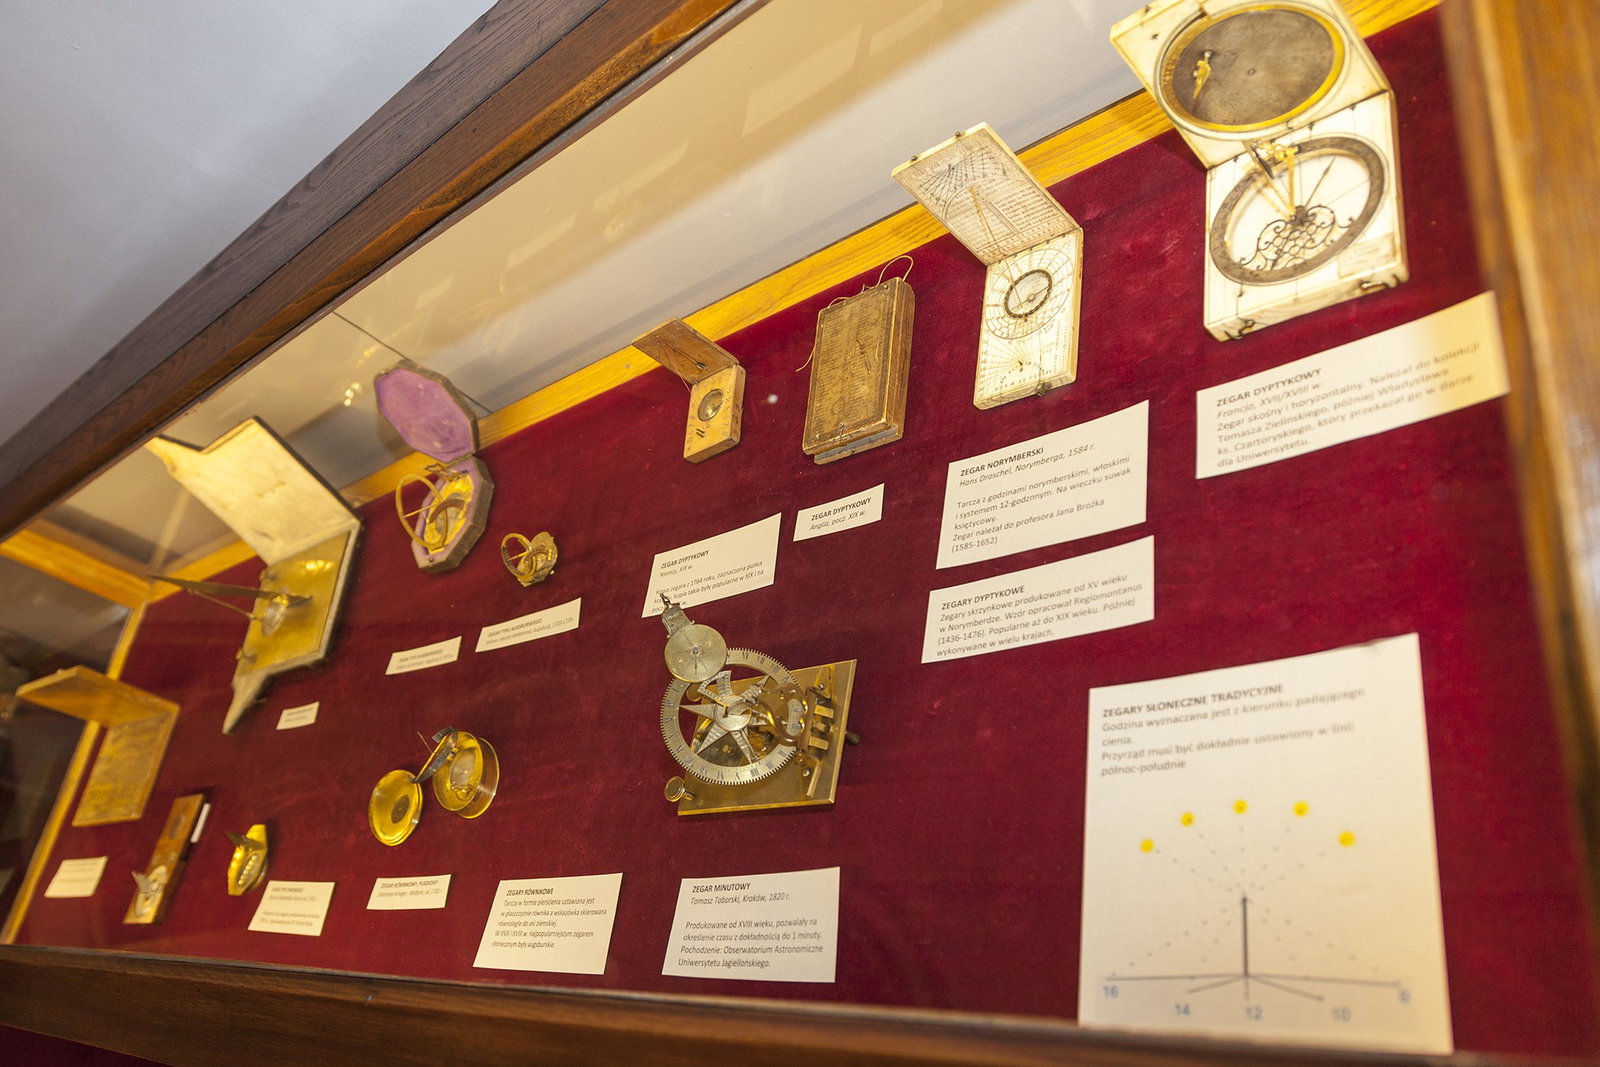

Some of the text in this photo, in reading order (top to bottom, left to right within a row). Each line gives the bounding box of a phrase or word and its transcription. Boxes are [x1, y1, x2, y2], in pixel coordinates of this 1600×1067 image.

[1217, 369, 1320, 407] ZEGAR DYPTYKOWY
[1217, 403, 1257, 419] Francja,
[1217, 418, 1245, 431] Zegar
[1248, 408, 1283, 423] skośny
[1318, 415, 1345, 427] który
[1218, 426, 1262, 443] Tomasza
[959, 478, 978, 487] Hans
[979, 467, 1013, 483] Droschel,
[1015, 453, 1065, 472] Norymberga,
[1068, 444, 1088, 457] 1584
[960, 447, 1043, 477] ZEGAR NORYMBERSKI
[1218, 458, 1234, 467] dla
[957, 499, 981, 508] Tarcza
[987, 484, 1027, 503] godzinami
[1028, 469, 1090, 490] norymberskimi,
[1093, 457, 1130, 472] włoskimi
[959, 504, 998, 519] systemem
[1069, 477, 1102, 490] wieczku
[1104, 467, 1130, 481] suwak
[811, 497, 871, 521] ZEGAR DYPTYKOWY
[953, 499, 1105, 541] Zegar należał do profesora Jana Brożka
[954, 516, 998, 530] księżycowy.
[952, 536, 998, 553] (1585-1652)
[661, 559, 678, 569] ZEGAR
[940, 576, 1127, 622] Zegary skrzynkowe produkowane od XV wieku
[942, 585, 1024, 610] ZEGARY DYPTYKOWE
[948, 616, 1002, 631] Norymberdze.
[1005, 610, 1026, 620] Wzór
[1028, 599, 1072, 616] opracował
[1074, 584, 1142, 605] Regiomontanus
[989, 622, 1030, 635] Popularne
[1043, 616, 1054, 624] do
[1056, 612, 1070, 621] XIX
[1072, 608, 1100, 618] wieku.
[937, 643, 987, 657] wykonywane
[998, 635, 1020, 645] wielu
[1022, 629, 1054, 641] krajach.
[1103, 684, 1282, 718] ZEGARY SŁONECZNE TRADYCYJNE
[1102, 721, 1143, 732] Godzina
[1146, 712, 1208, 727] wyznaczana
[1211, 708, 1230, 720] jest
[1242, 700, 1292, 713] kierunku
[1102, 749, 1145, 761] Przyrząd
[1148, 747, 1172, 756] musi
[1175, 744, 1193, 754] być
[691, 897, 713, 905] Tomasz
[714, 895, 741, 904] Taborski,
[742, 894, 767, 902] Kraków,
[769, 892, 785, 901] 1820
[692, 883, 751, 893] ZEGAR MINUTOWY
[683, 933, 715, 941] określenie
[781, 932, 791, 940] do
[685, 921, 728, 930] Produkowane
[728, 921, 737, 929] od
[738, 920, 753, 928] XVIII
[680, 945, 823, 954] Pochodzenie: Obserwatorium Astronomiczne
[678, 958, 721, 968] Uniwersytetu
